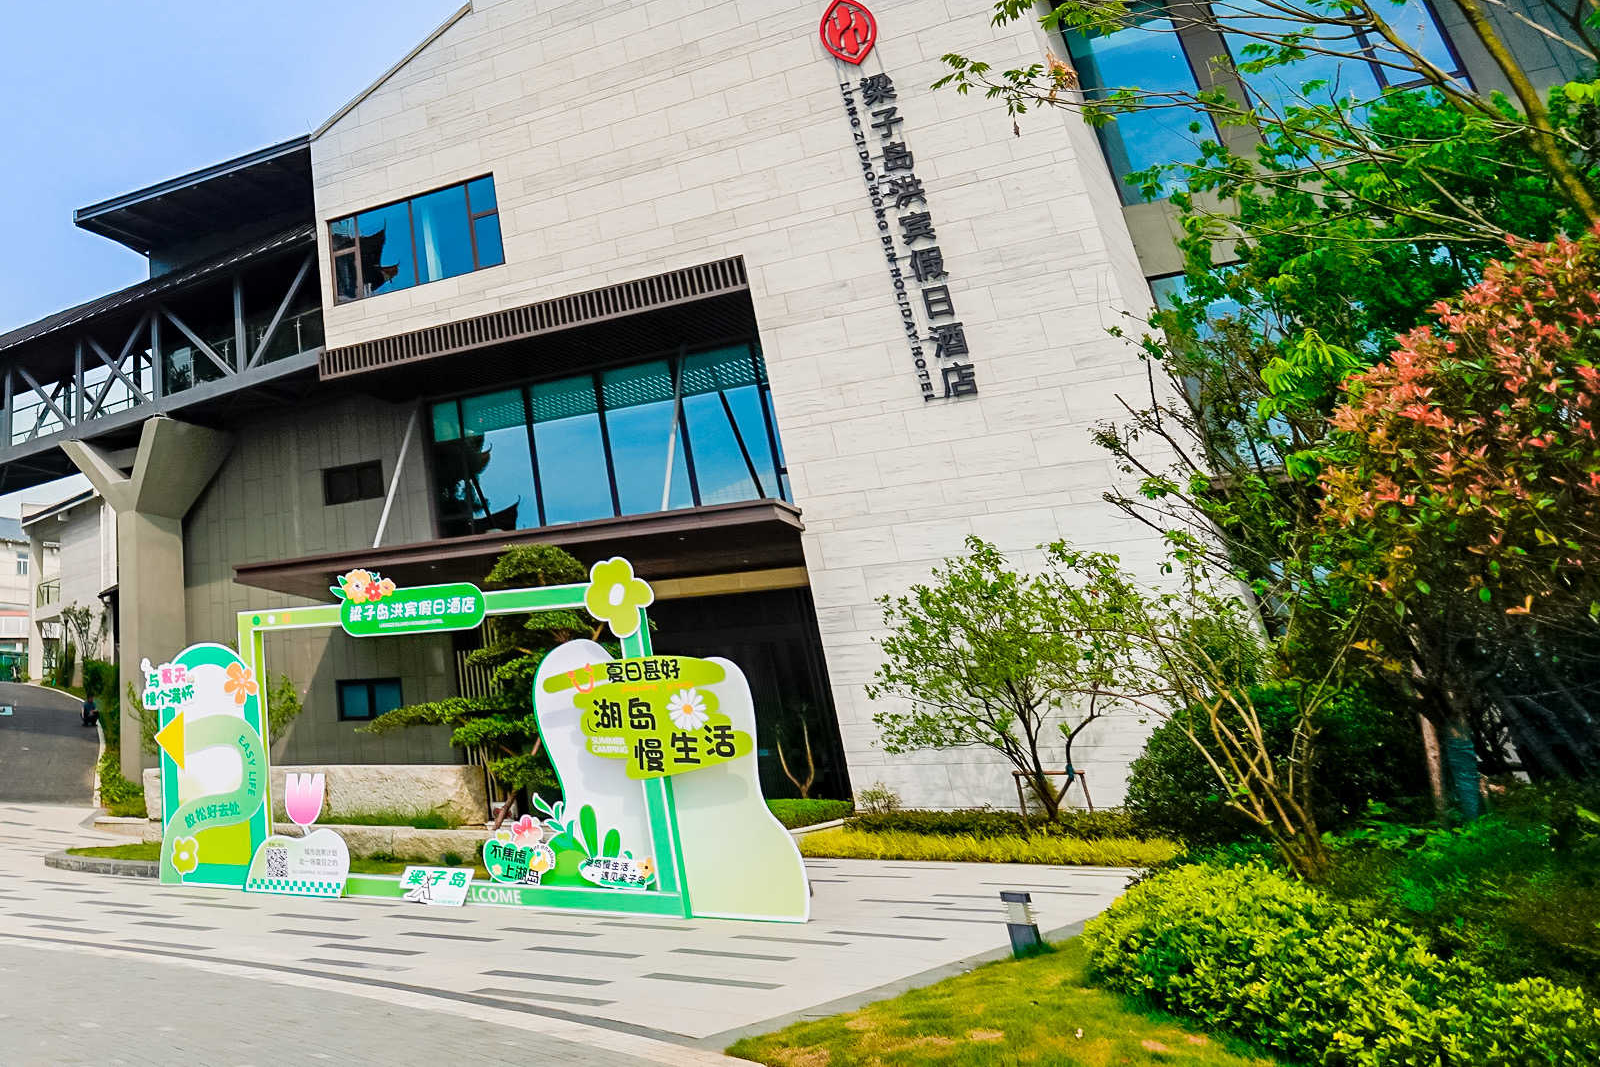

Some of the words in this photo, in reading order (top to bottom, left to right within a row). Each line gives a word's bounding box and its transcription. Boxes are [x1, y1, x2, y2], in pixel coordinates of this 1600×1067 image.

[840, 81, 861, 128] LIANG
[859, 150, 876, 182] DAO
[868, 184, 889, 231] HONG
[881, 235, 897, 264] BIN
[890, 267, 920, 343] HOLIDAY
[911, 345, 936, 403] HOTEL
[859, 73, 978, 399] 梁子岛洪宾假日酒店
[349, 596, 476, 622] 梁子岛洪宾假日酒店
[605, 659, 681, 684] 夏日甚好
[592, 697, 657, 731] 湖岛
[238, 734, 257, 766] EASY
[591, 736, 625, 745] SUMMER
[591, 745, 629, 754] CAMPING
[634, 725, 736, 773] 慢生活
[247, 771, 257, 797] LIFE
[490, 844, 527, 865] 不焦虑
[406, 869, 467, 888] 梁子岛
[466, 886, 523, 904] ELCOME
